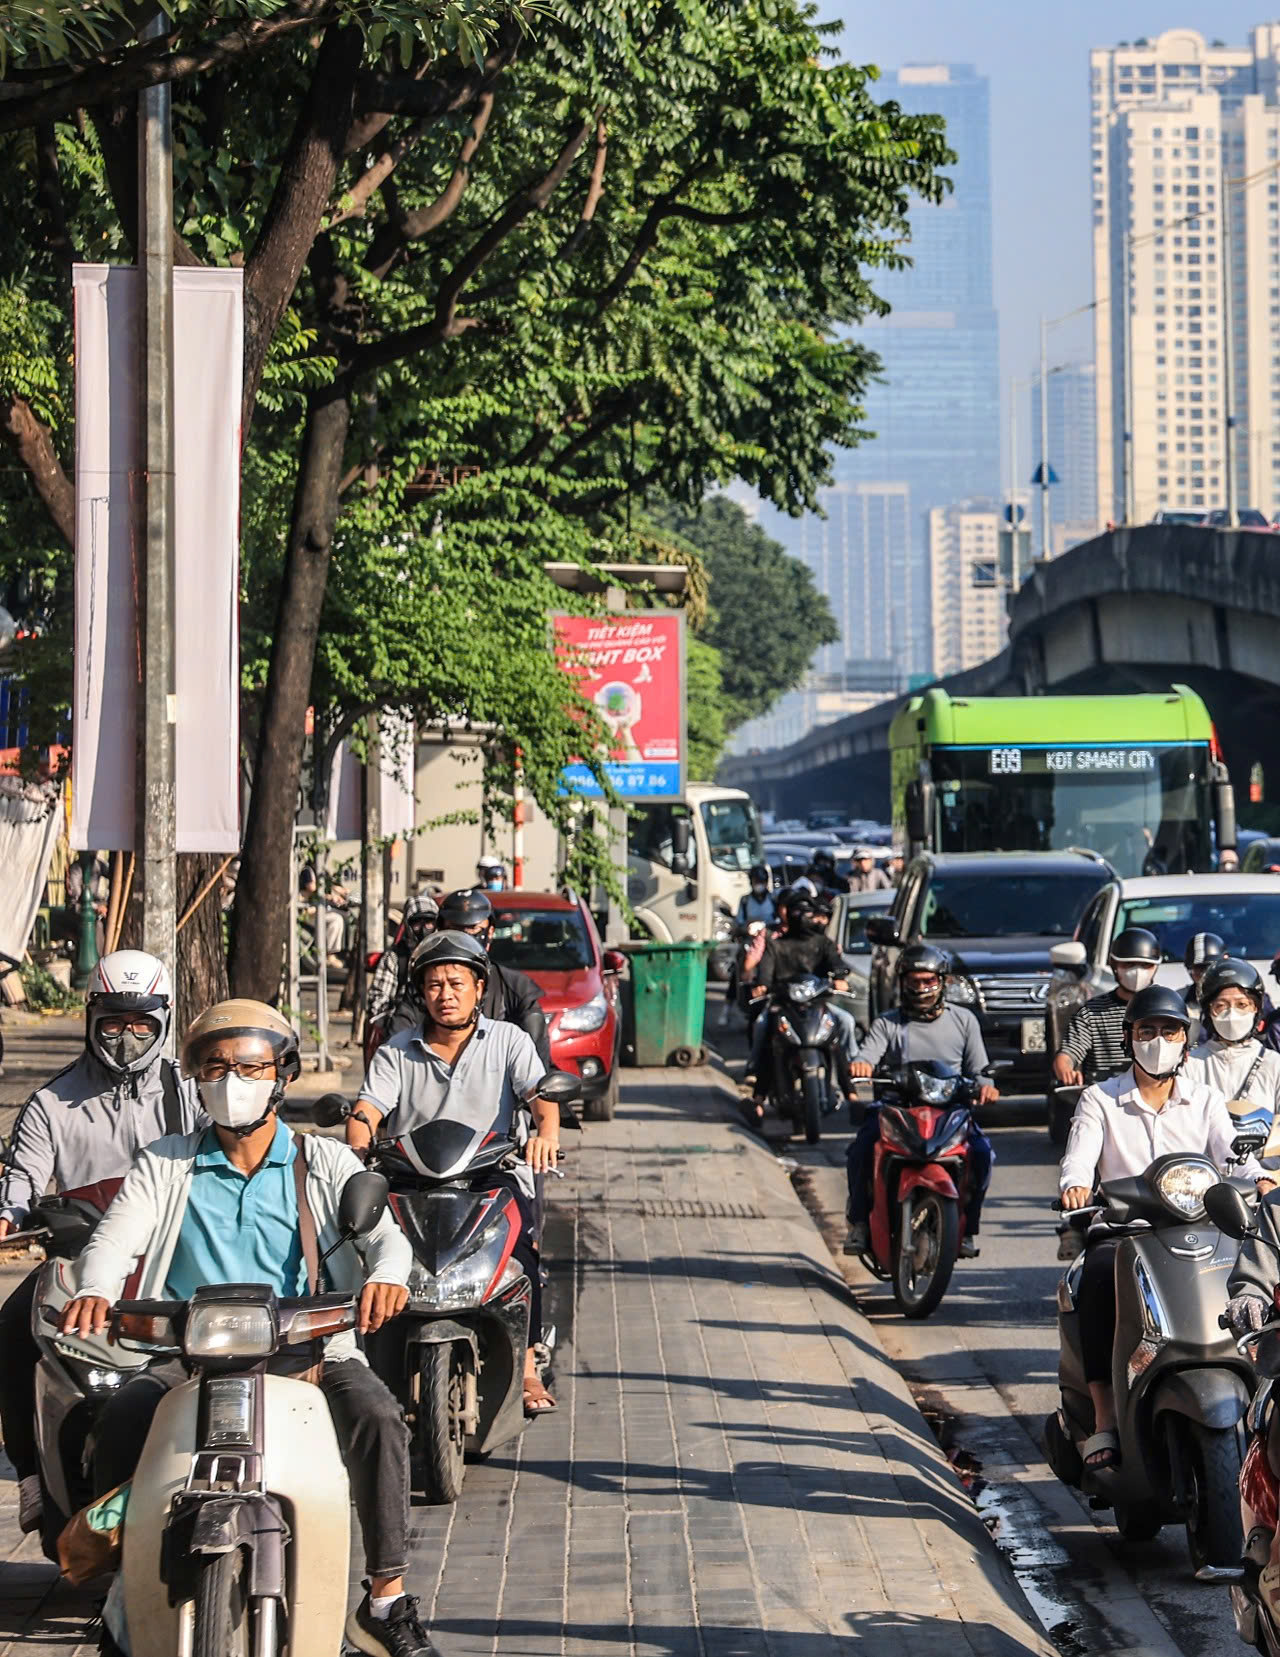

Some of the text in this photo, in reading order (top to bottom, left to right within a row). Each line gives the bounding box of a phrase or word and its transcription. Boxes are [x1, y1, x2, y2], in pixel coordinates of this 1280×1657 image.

[588, 622, 653, 640] TIẾT KIỆM
[622, 645, 667, 665] BOX
[991, 749, 1022, 773] E09
[1076, 751, 1126, 769] SMART
[1129, 750, 1155, 769] CITY
